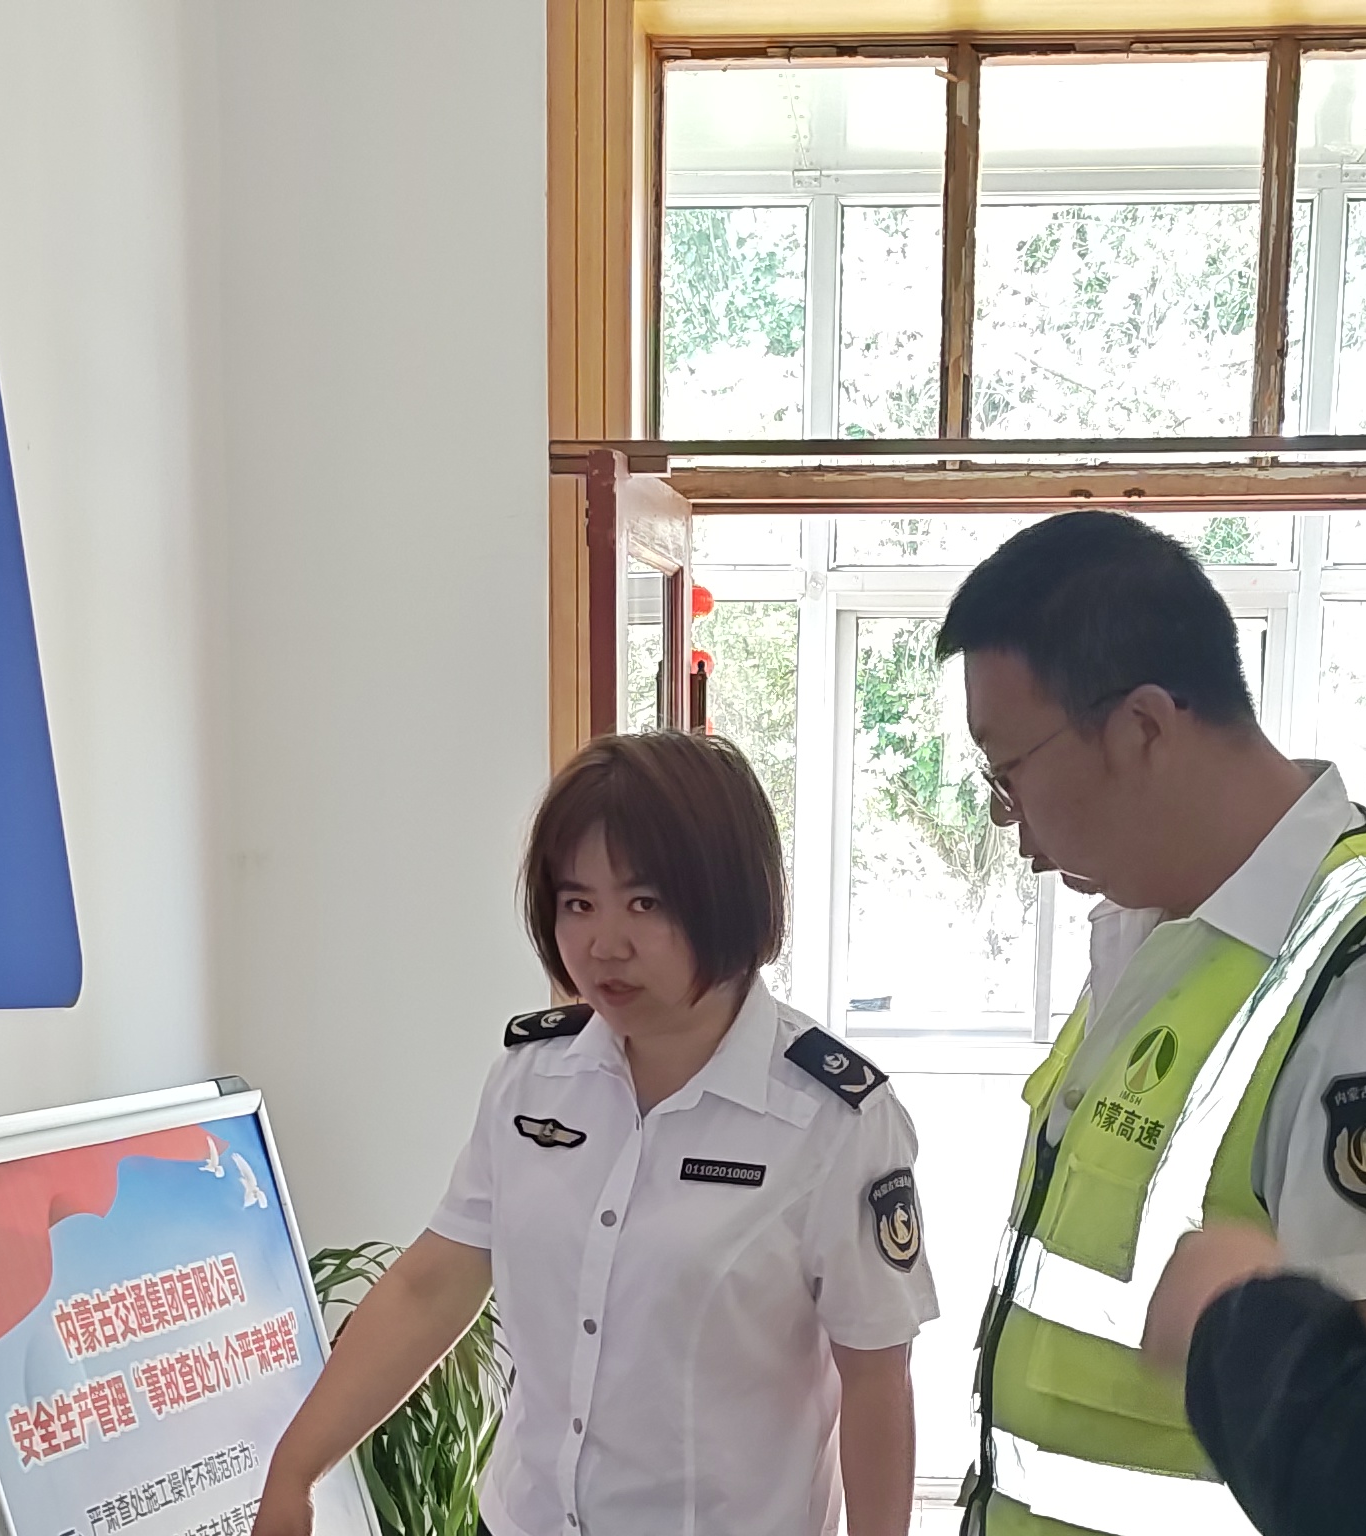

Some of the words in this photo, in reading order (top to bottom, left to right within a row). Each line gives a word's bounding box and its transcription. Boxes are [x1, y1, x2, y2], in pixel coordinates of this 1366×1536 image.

[1090, 1096, 1166, 1151] 内蒙高速
[684, 1163, 762, 1181] 01102010009
[54, 1256, 247, 1359] 内蒙古交通集团有限公司
